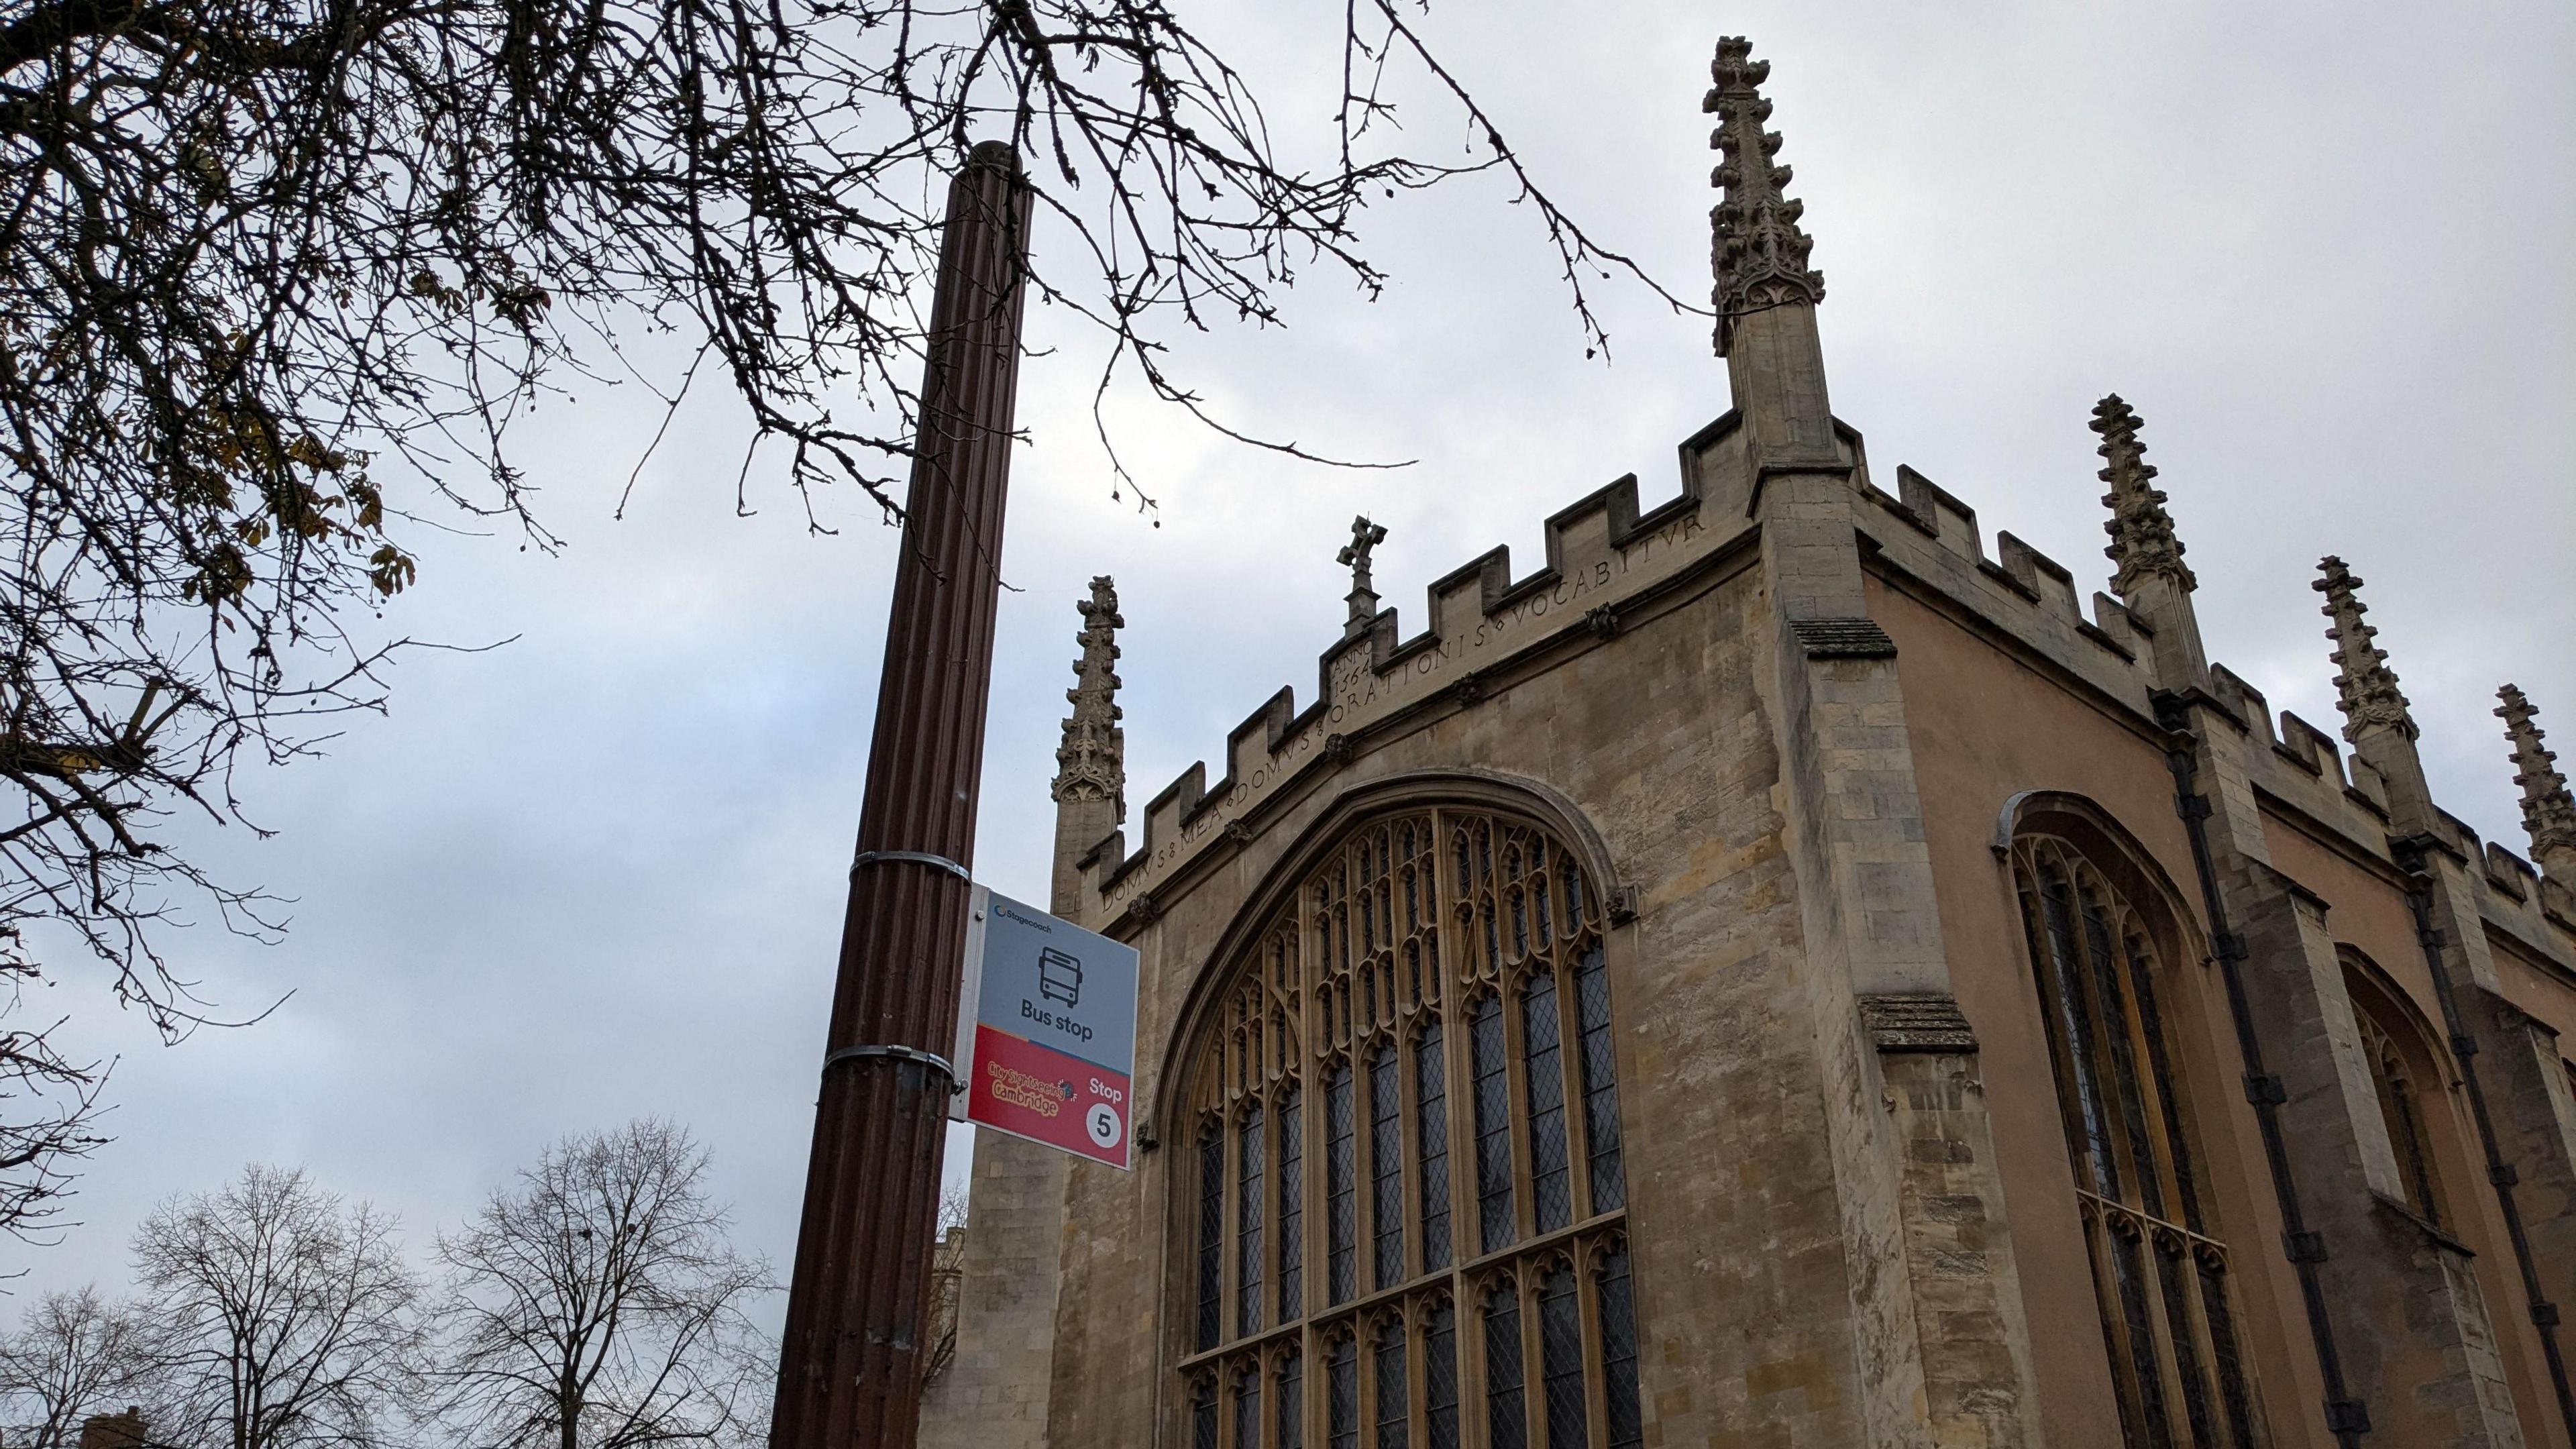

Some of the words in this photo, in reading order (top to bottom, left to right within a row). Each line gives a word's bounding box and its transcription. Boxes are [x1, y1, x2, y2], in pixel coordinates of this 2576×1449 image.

[1332, 640, 1373, 679] ANNO
[1334, 657, 1373, 698] 1564
[1180, 804, 1223, 851] MEA
[1330, 624, 1486, 722] ORATIONIS
[1511, 514, 1705, 626] VOCABITVR
[1006, 910, 1051, 934] Stagecoach
[1021, 998, 1052, 1026] Bus
[1056, 1016, 1093, 1042] stop
[989, 1061, 1008, 1081] City
[1008, 1069, 1066, 1101] Sightseeing
[992, 1079, 1058, 1116] Cambridge
[1089, 1077, 1122, 1104] Stop
[1096, 1112, 1111, 1137] 5
